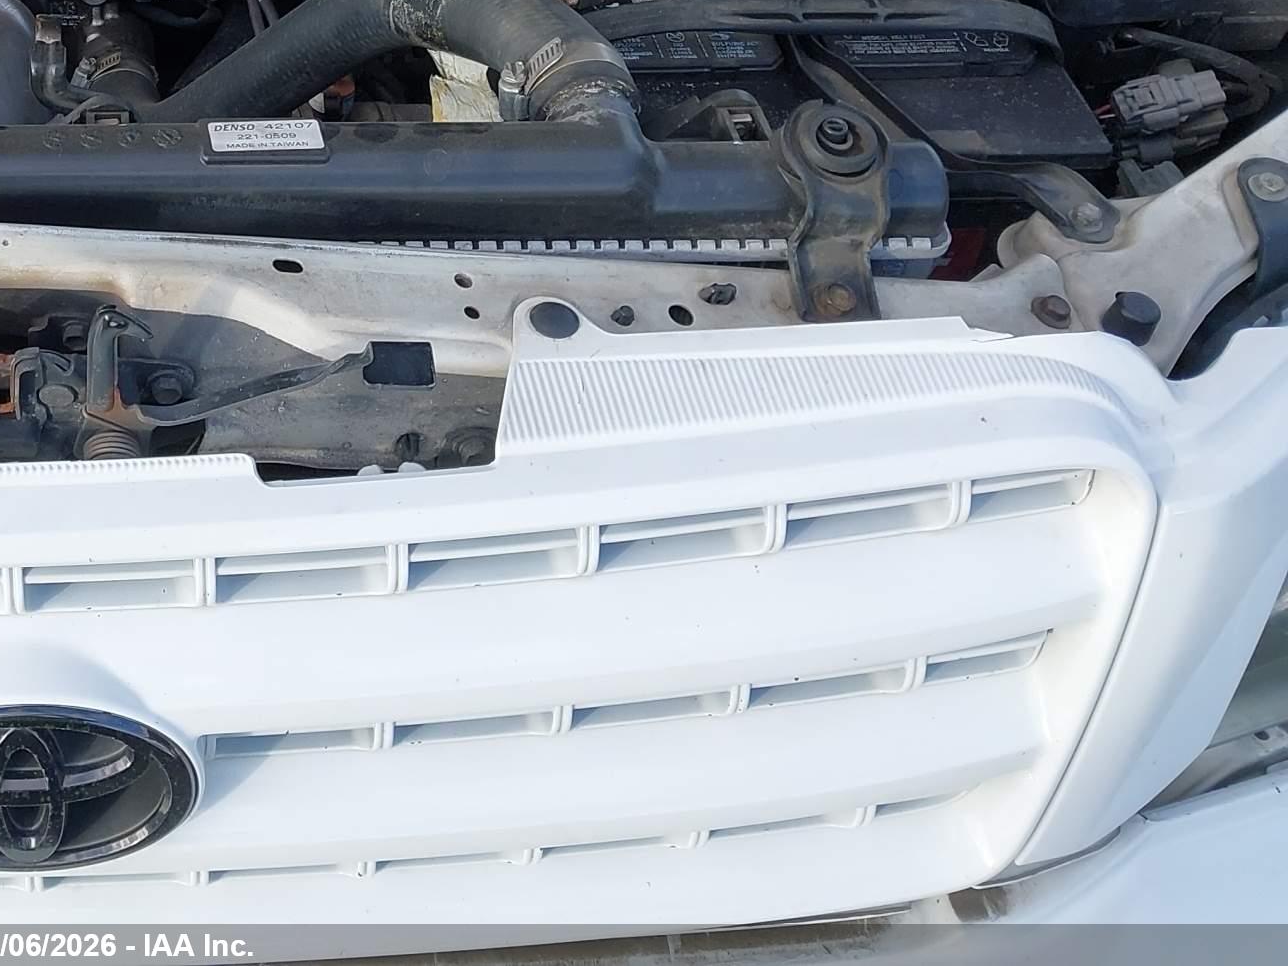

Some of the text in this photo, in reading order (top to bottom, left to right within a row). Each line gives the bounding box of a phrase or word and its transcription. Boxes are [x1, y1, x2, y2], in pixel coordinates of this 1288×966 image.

[214, 121, 313, 132] DENSO 42107
[237, 132, 297, 140] 221-0509
